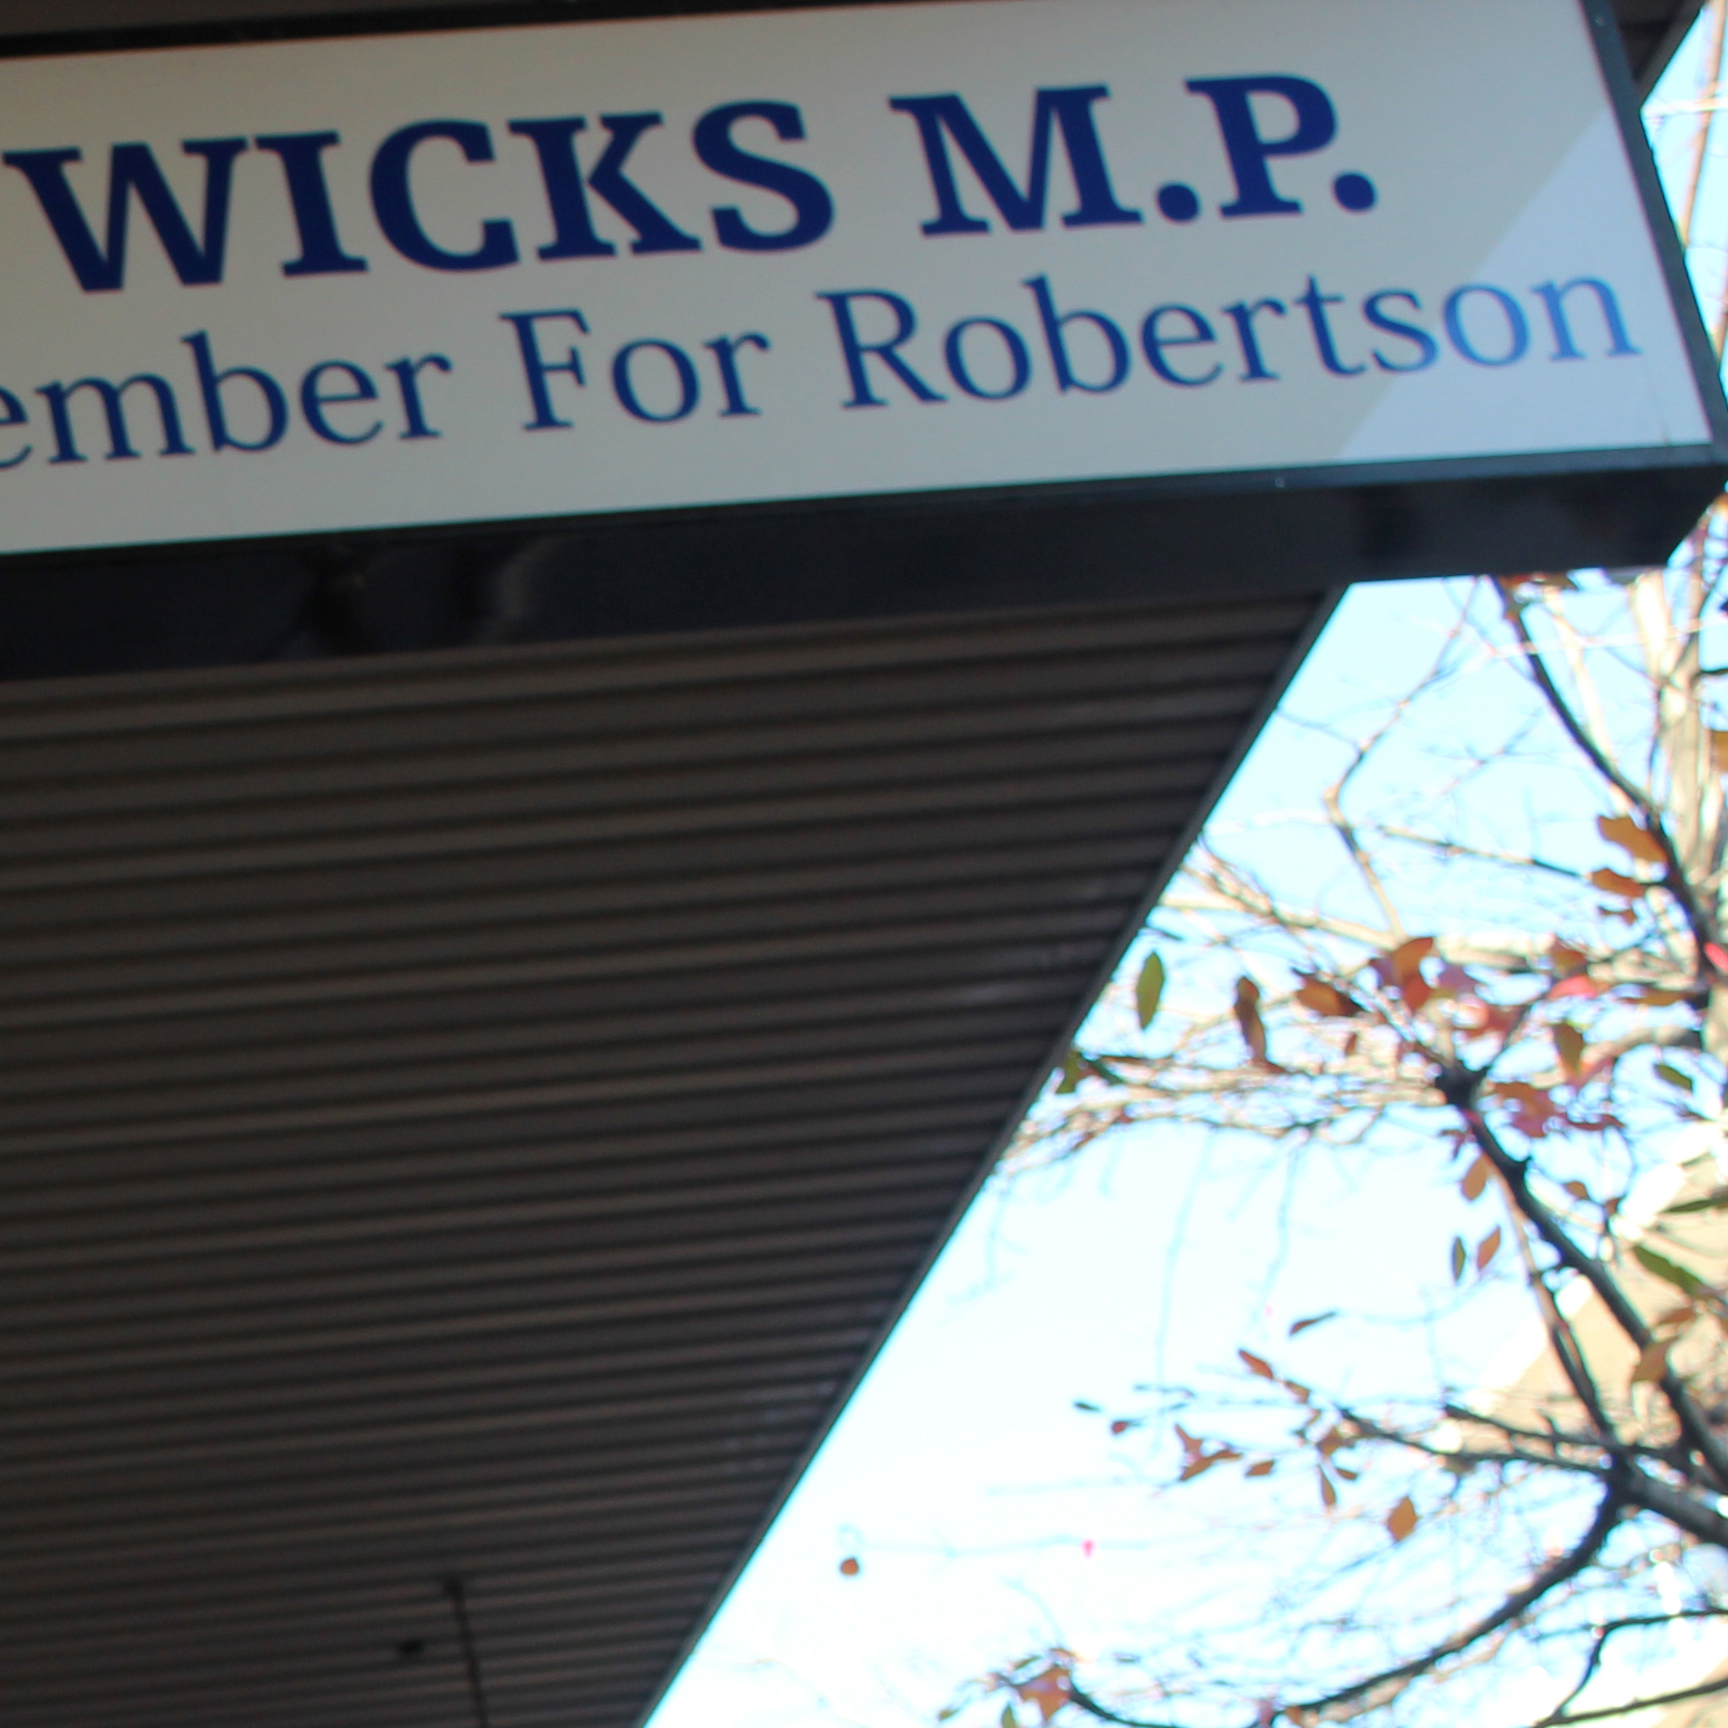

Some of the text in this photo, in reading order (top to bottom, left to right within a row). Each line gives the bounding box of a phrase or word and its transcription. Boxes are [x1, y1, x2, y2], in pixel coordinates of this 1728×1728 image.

[1, 98, 835, 292] WICKS
[889, 72, 1379, 236] M.P.
[501, 308, 771, 430] For
[817, 274, 1639, 407] Robertson
